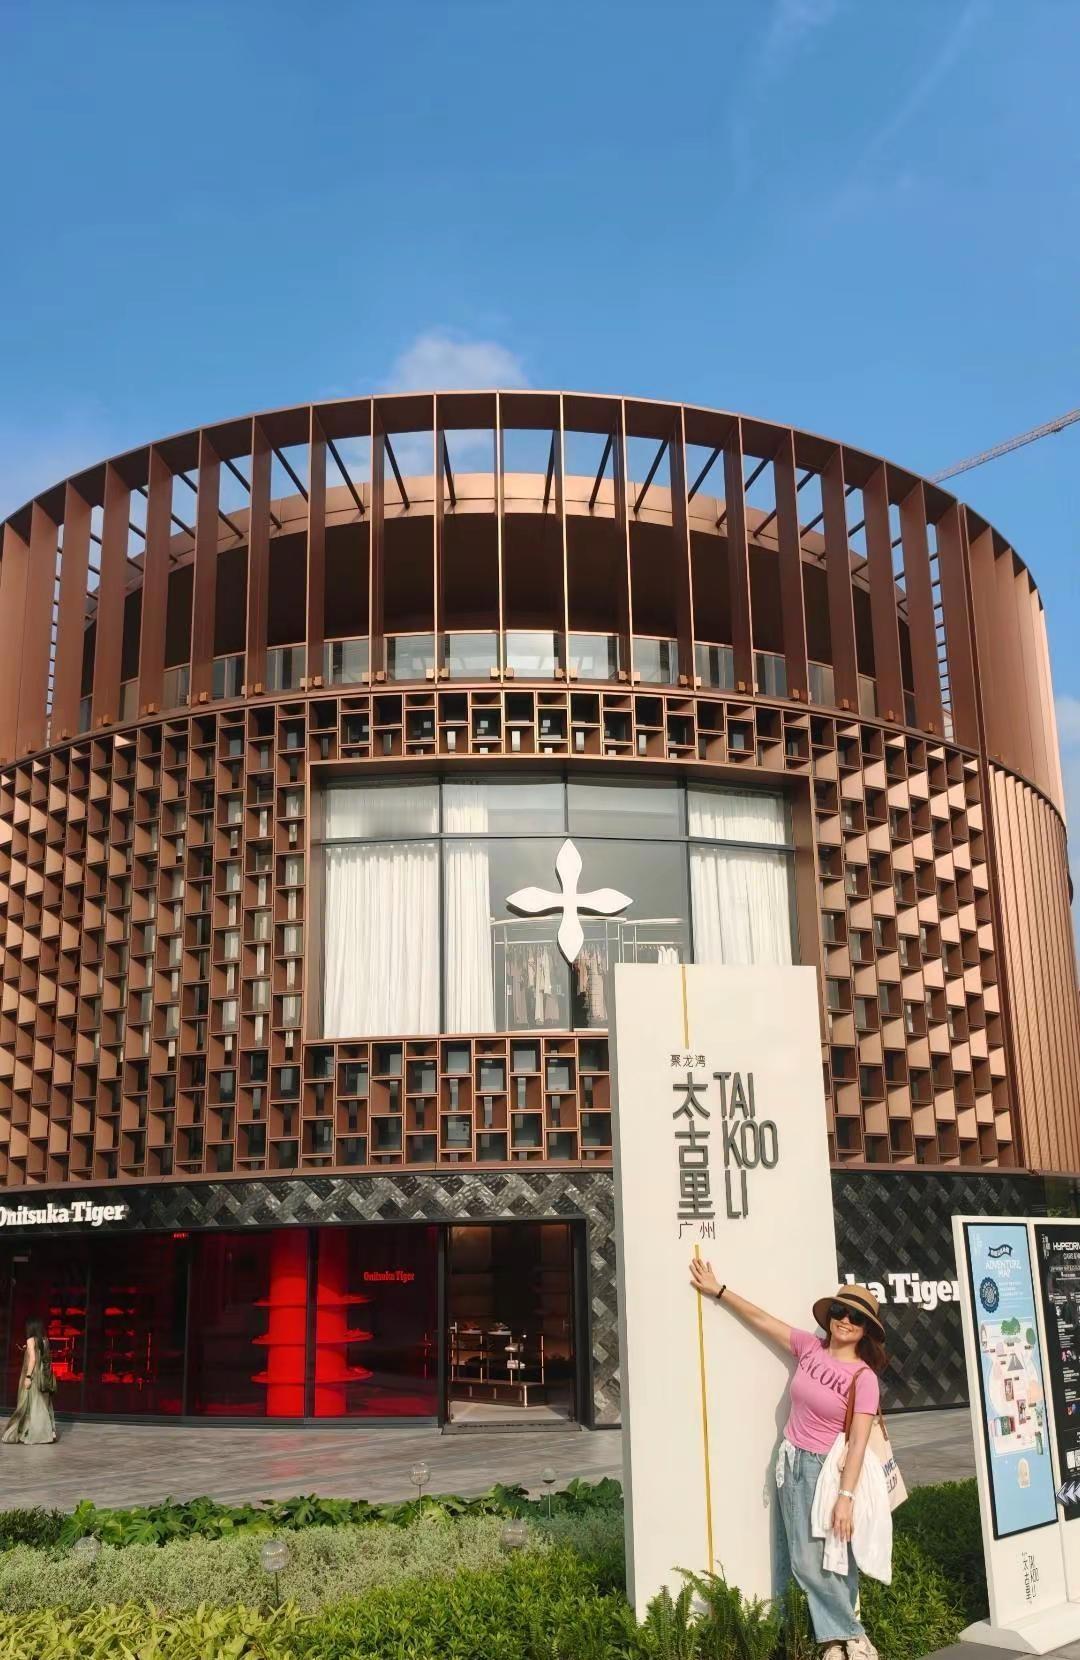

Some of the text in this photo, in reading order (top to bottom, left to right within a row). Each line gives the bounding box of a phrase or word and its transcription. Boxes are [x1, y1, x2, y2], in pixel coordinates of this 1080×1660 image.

[670, 1054, 706, 1068] 聚龙湾
[713, 1071, 756, 1120] TAI
[672, 1071, 716, 1220] 太古里
[722, 1119, 779, 1170] KOO
[724, 1169, 749, 1220] LI
[71, 1201, 126, 1227] Tiger
[678, 1221, 716, 1240] 广州
[364, 1270, 415, 1284] Onitsuka Tiger
